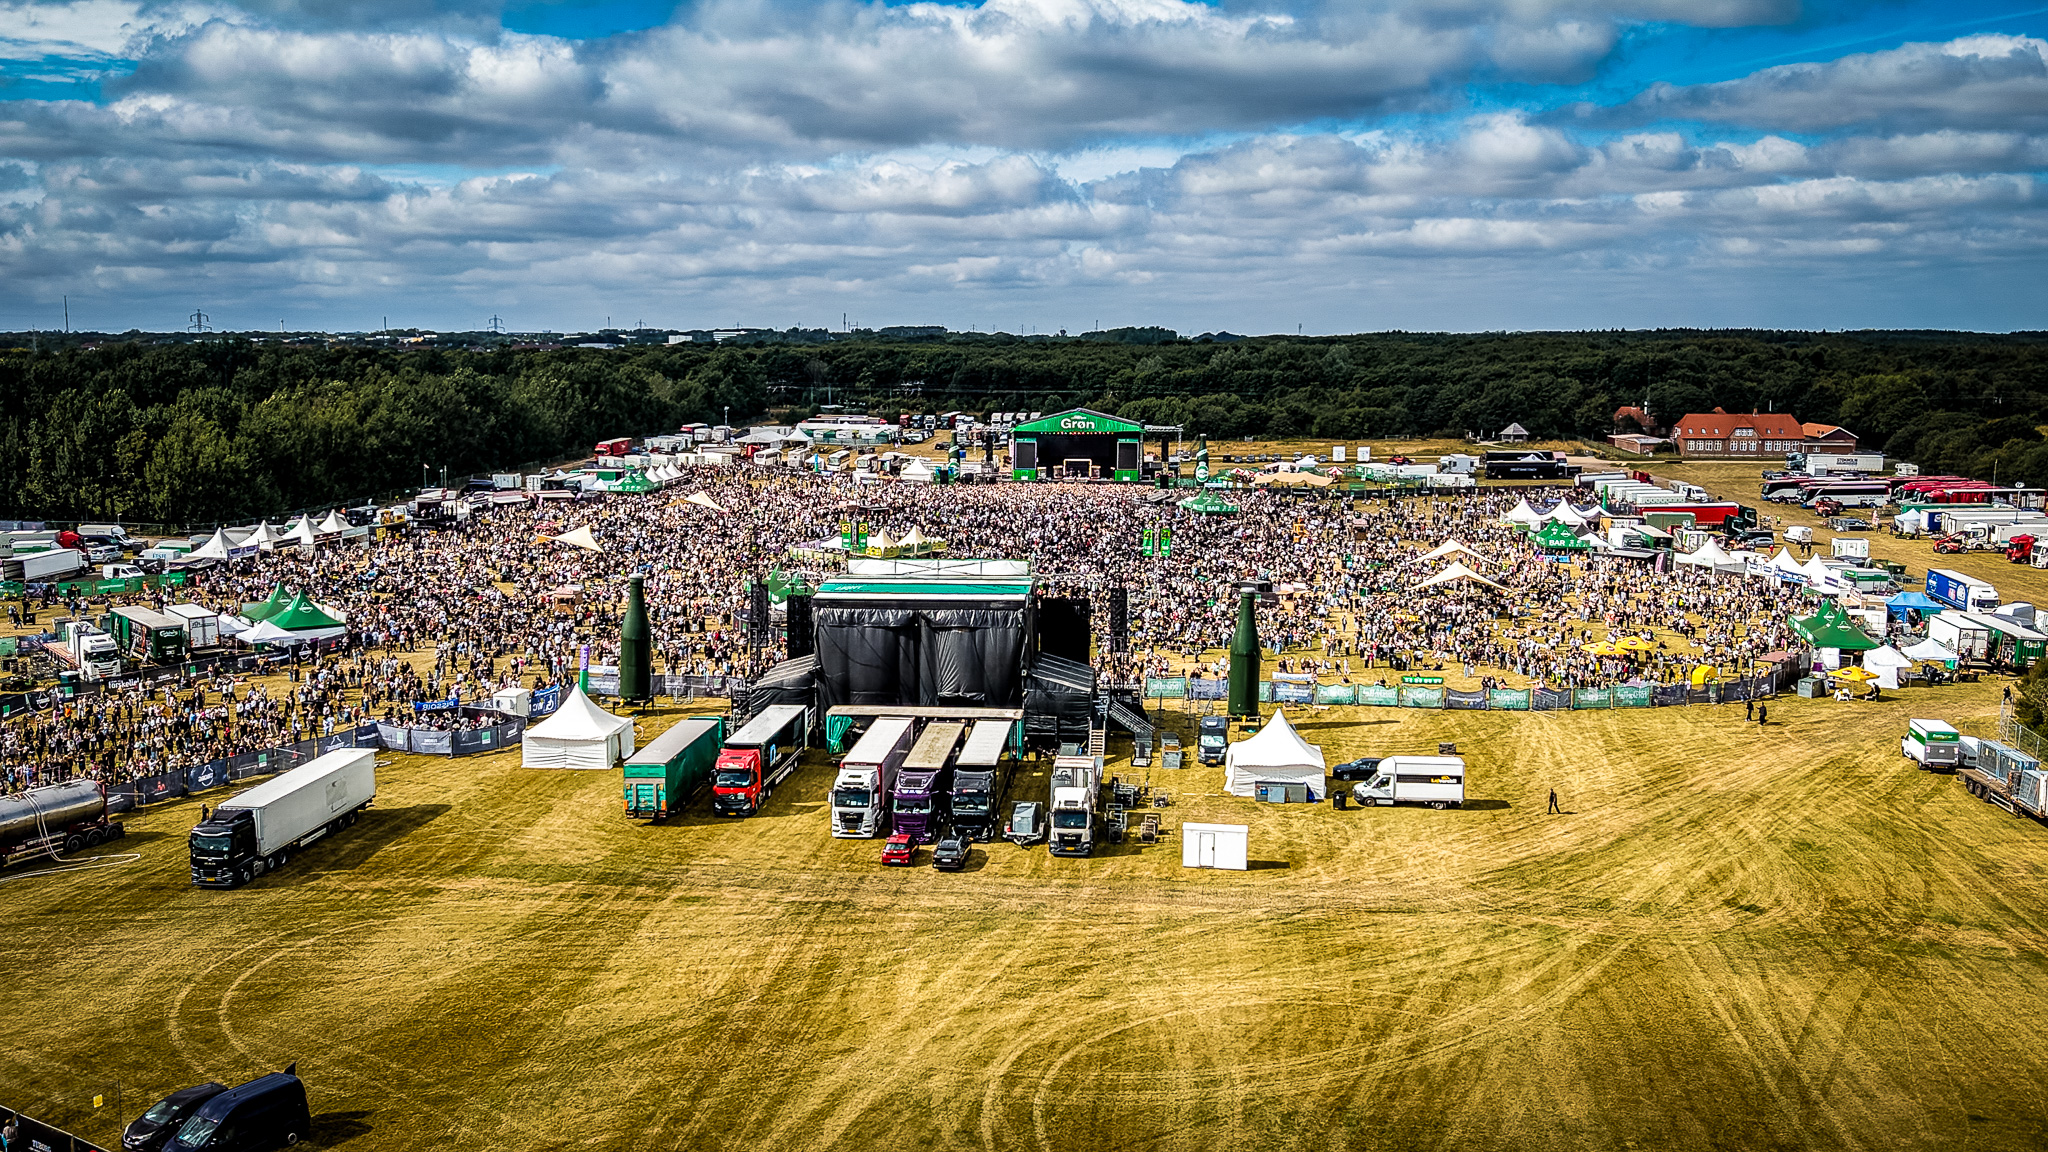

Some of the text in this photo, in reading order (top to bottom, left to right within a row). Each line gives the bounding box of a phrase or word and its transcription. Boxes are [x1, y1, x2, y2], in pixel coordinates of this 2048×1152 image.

[1061, 418, 1095, 429] Grøn
[1144, 531, 1151, 540] 4
[1161, 531, 1169, 540] 4
